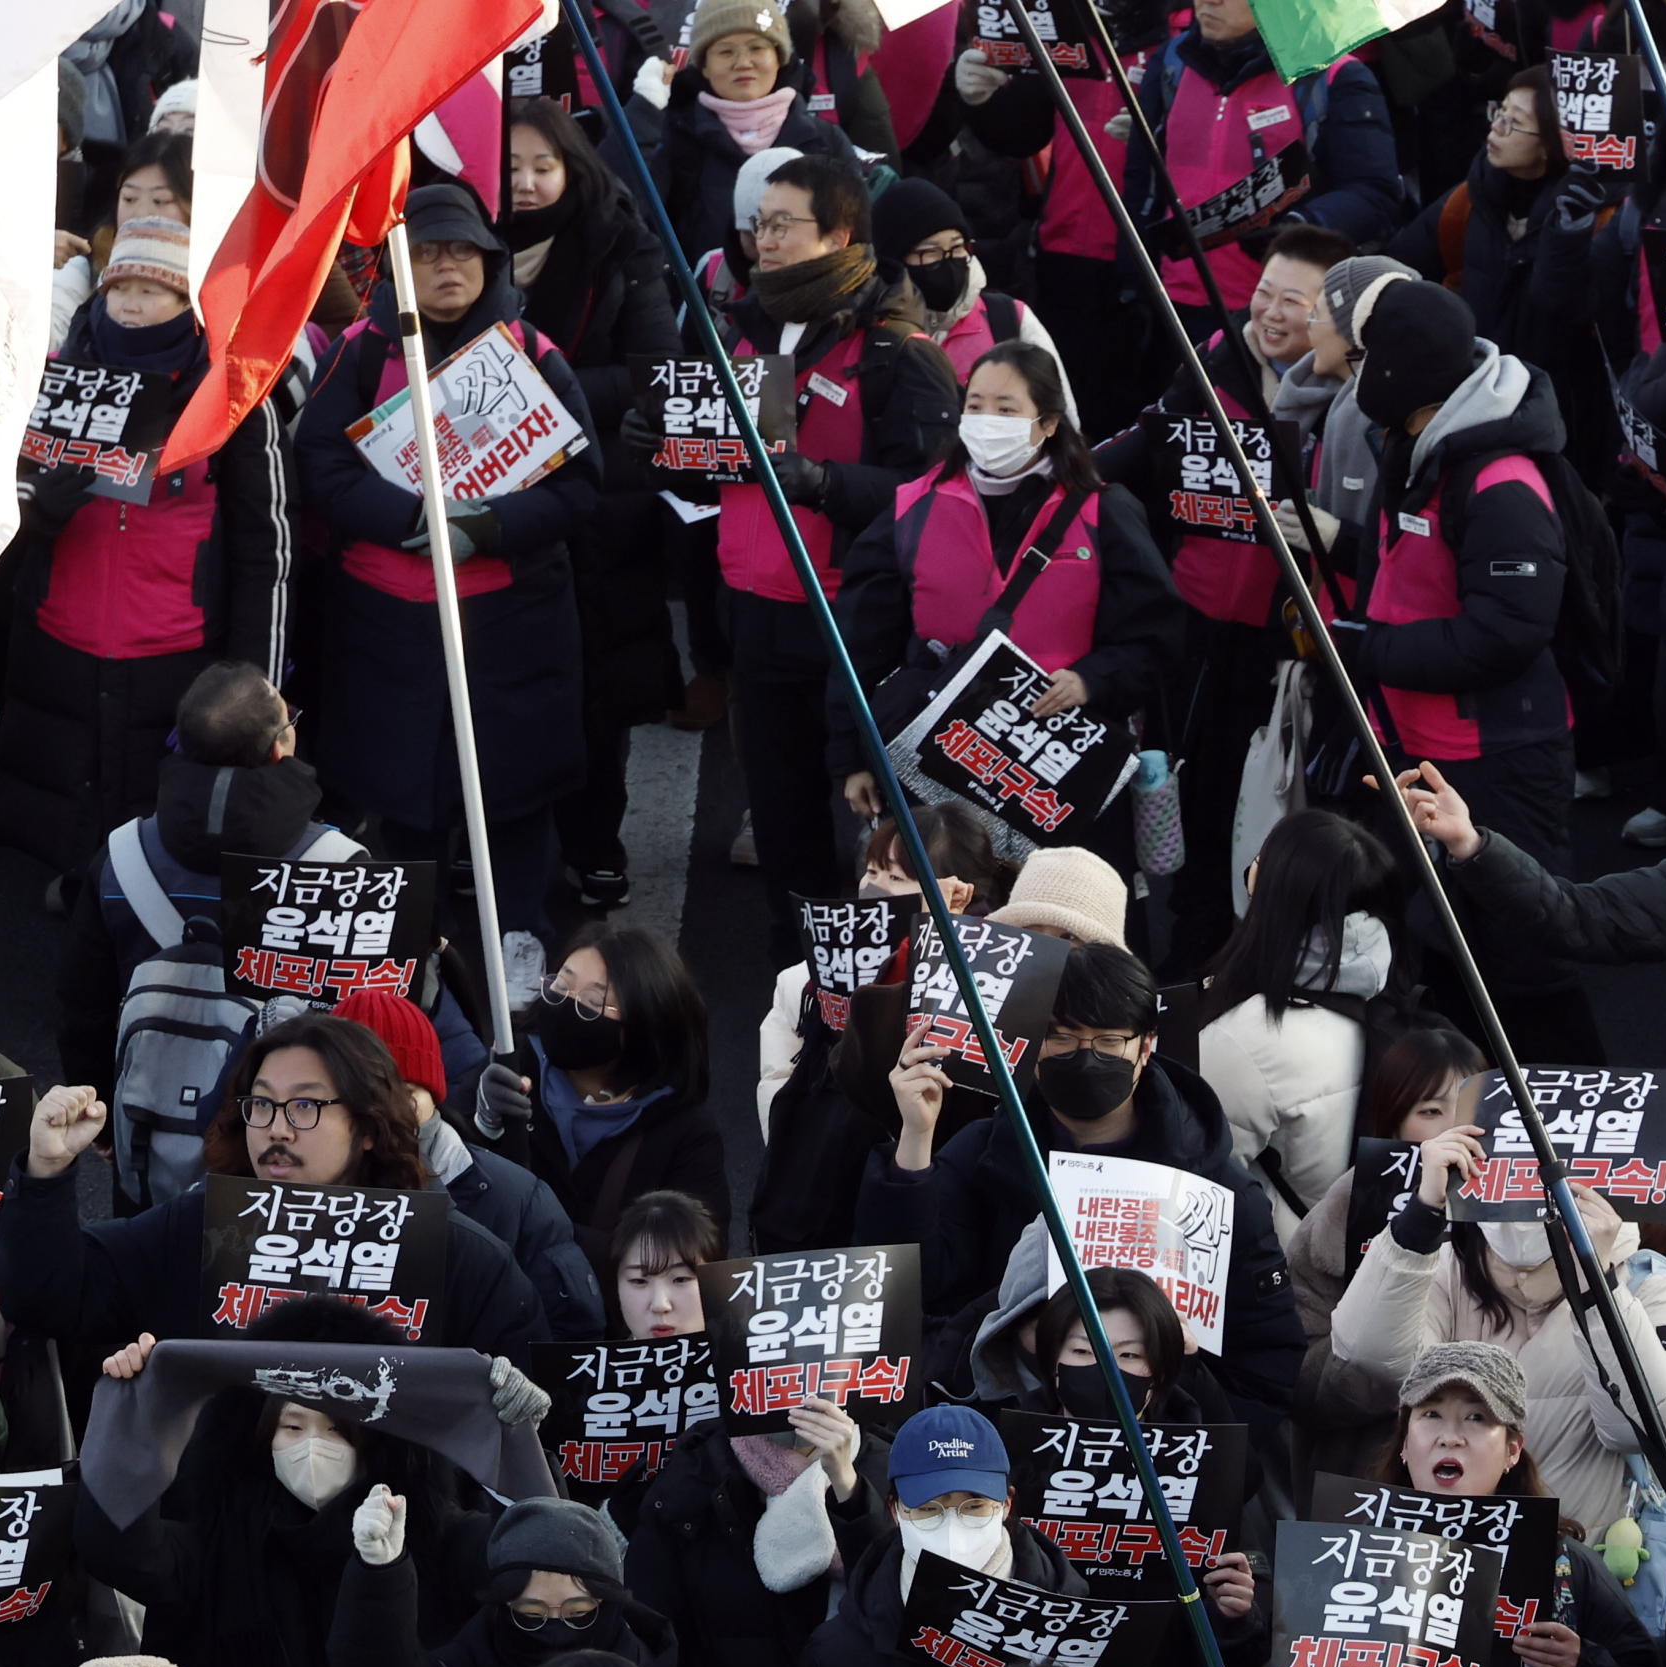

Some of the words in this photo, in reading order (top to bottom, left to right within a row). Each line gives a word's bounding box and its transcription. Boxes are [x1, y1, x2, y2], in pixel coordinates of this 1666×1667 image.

[44, 362, 144, 407] 금당장
[21, 429, 149, 485] 포!구속!
[974, 699, 1082, 786] 윤석열
[934, 719, 1075, 832] 체포!구속!
[250, 864, 408, 908] 지금당장
[261, 906, 397, 957] 윤석열
[799, 902, 895, 945] 지금당장
[233, 947, 417, 999] 체포!구속!
[1492, 1109, 1646, 1157] 윤석열
[237, 1186, 415, 1242] 지금당장
[1075, 1221, 1157, 1244] 내란동조
[1077, 1197, 1161, 1221] 내란공범
[247, 1237, 401, 1291] 윤석열
[729, 1253, 893, 1310] 지금당장
[745, 1304, 884, 1362] 윤석열
[582, 1382, 720, 1437] 윤석열
[728, 1357, 909, 1417] 체포!구속!
[928, 1438, 975, 1455] Deadline
[936, 1445, 969, 1459] Artist
[1311, 1530, 1475, 1595] 지금당장
[950, 1571, 1129, 1640] 지금당장
[1322, 1580, 1466, 1651] 윤석열
